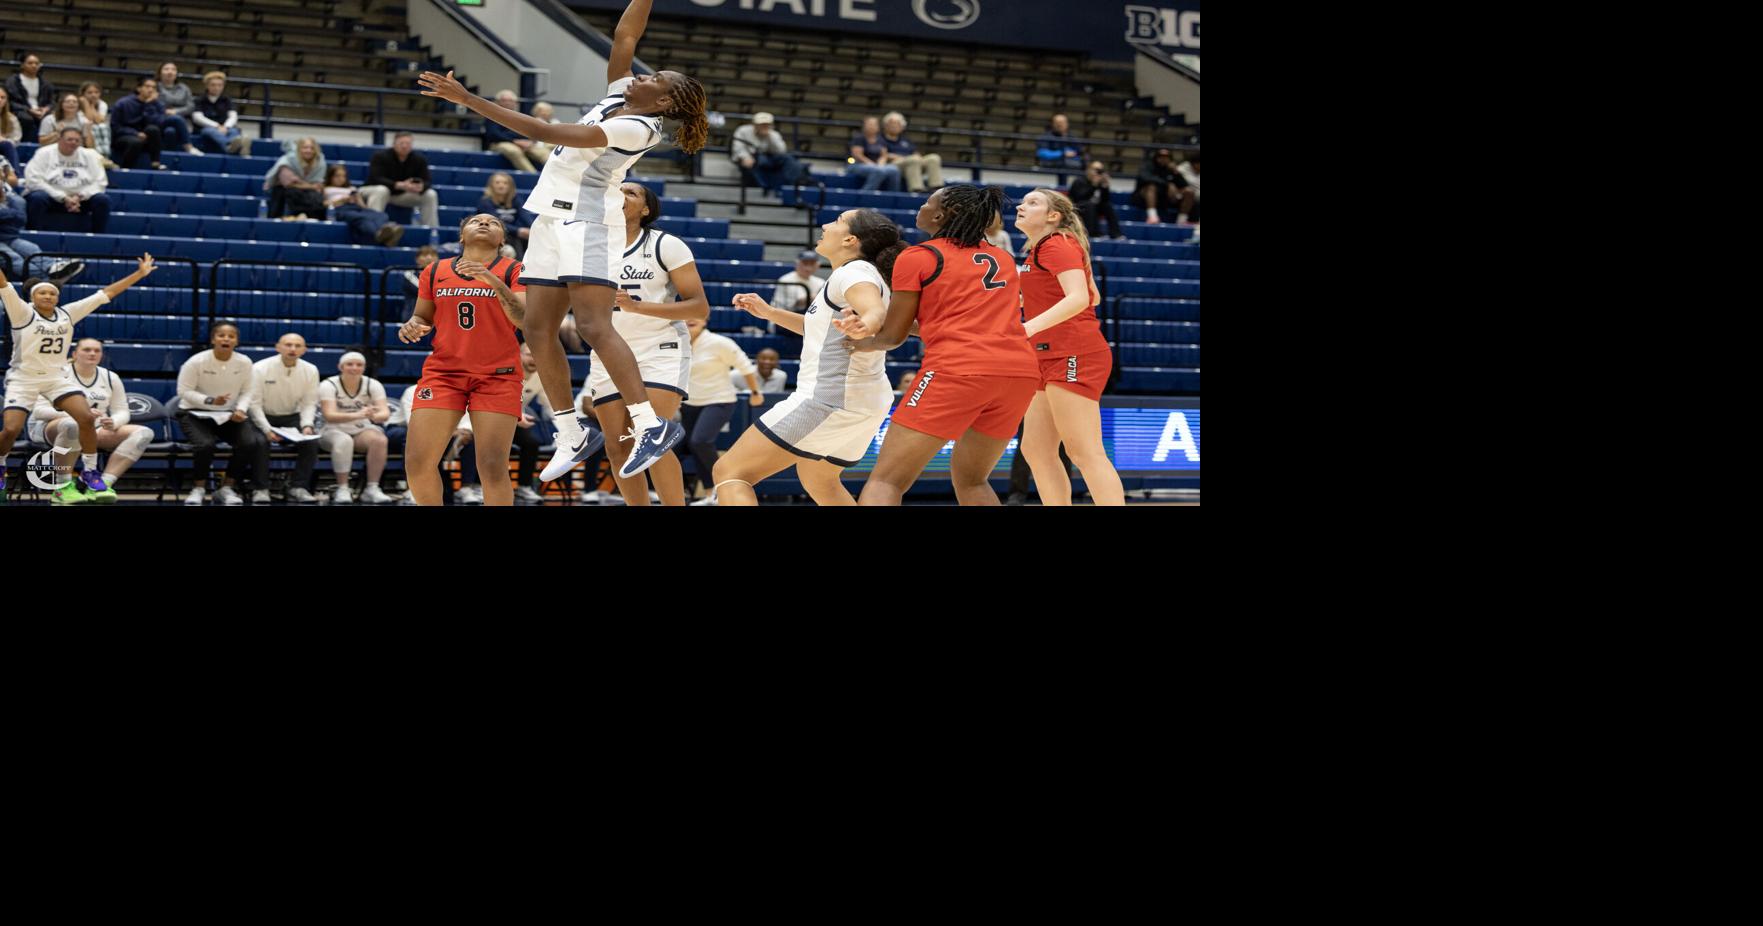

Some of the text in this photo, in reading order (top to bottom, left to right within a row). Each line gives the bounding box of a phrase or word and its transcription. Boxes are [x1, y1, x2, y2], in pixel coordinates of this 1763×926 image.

[620, 265, 654, 280] State
[972, 252, 1007, 290] 2
[436, 287, 498, 298] CALIFORNI
[457, 301, 475, 331] 8
[39, 337, 64, 354] 23
[1066, 355, 1078, 383] VULCA
[1152, 412, 1200, 462] A
